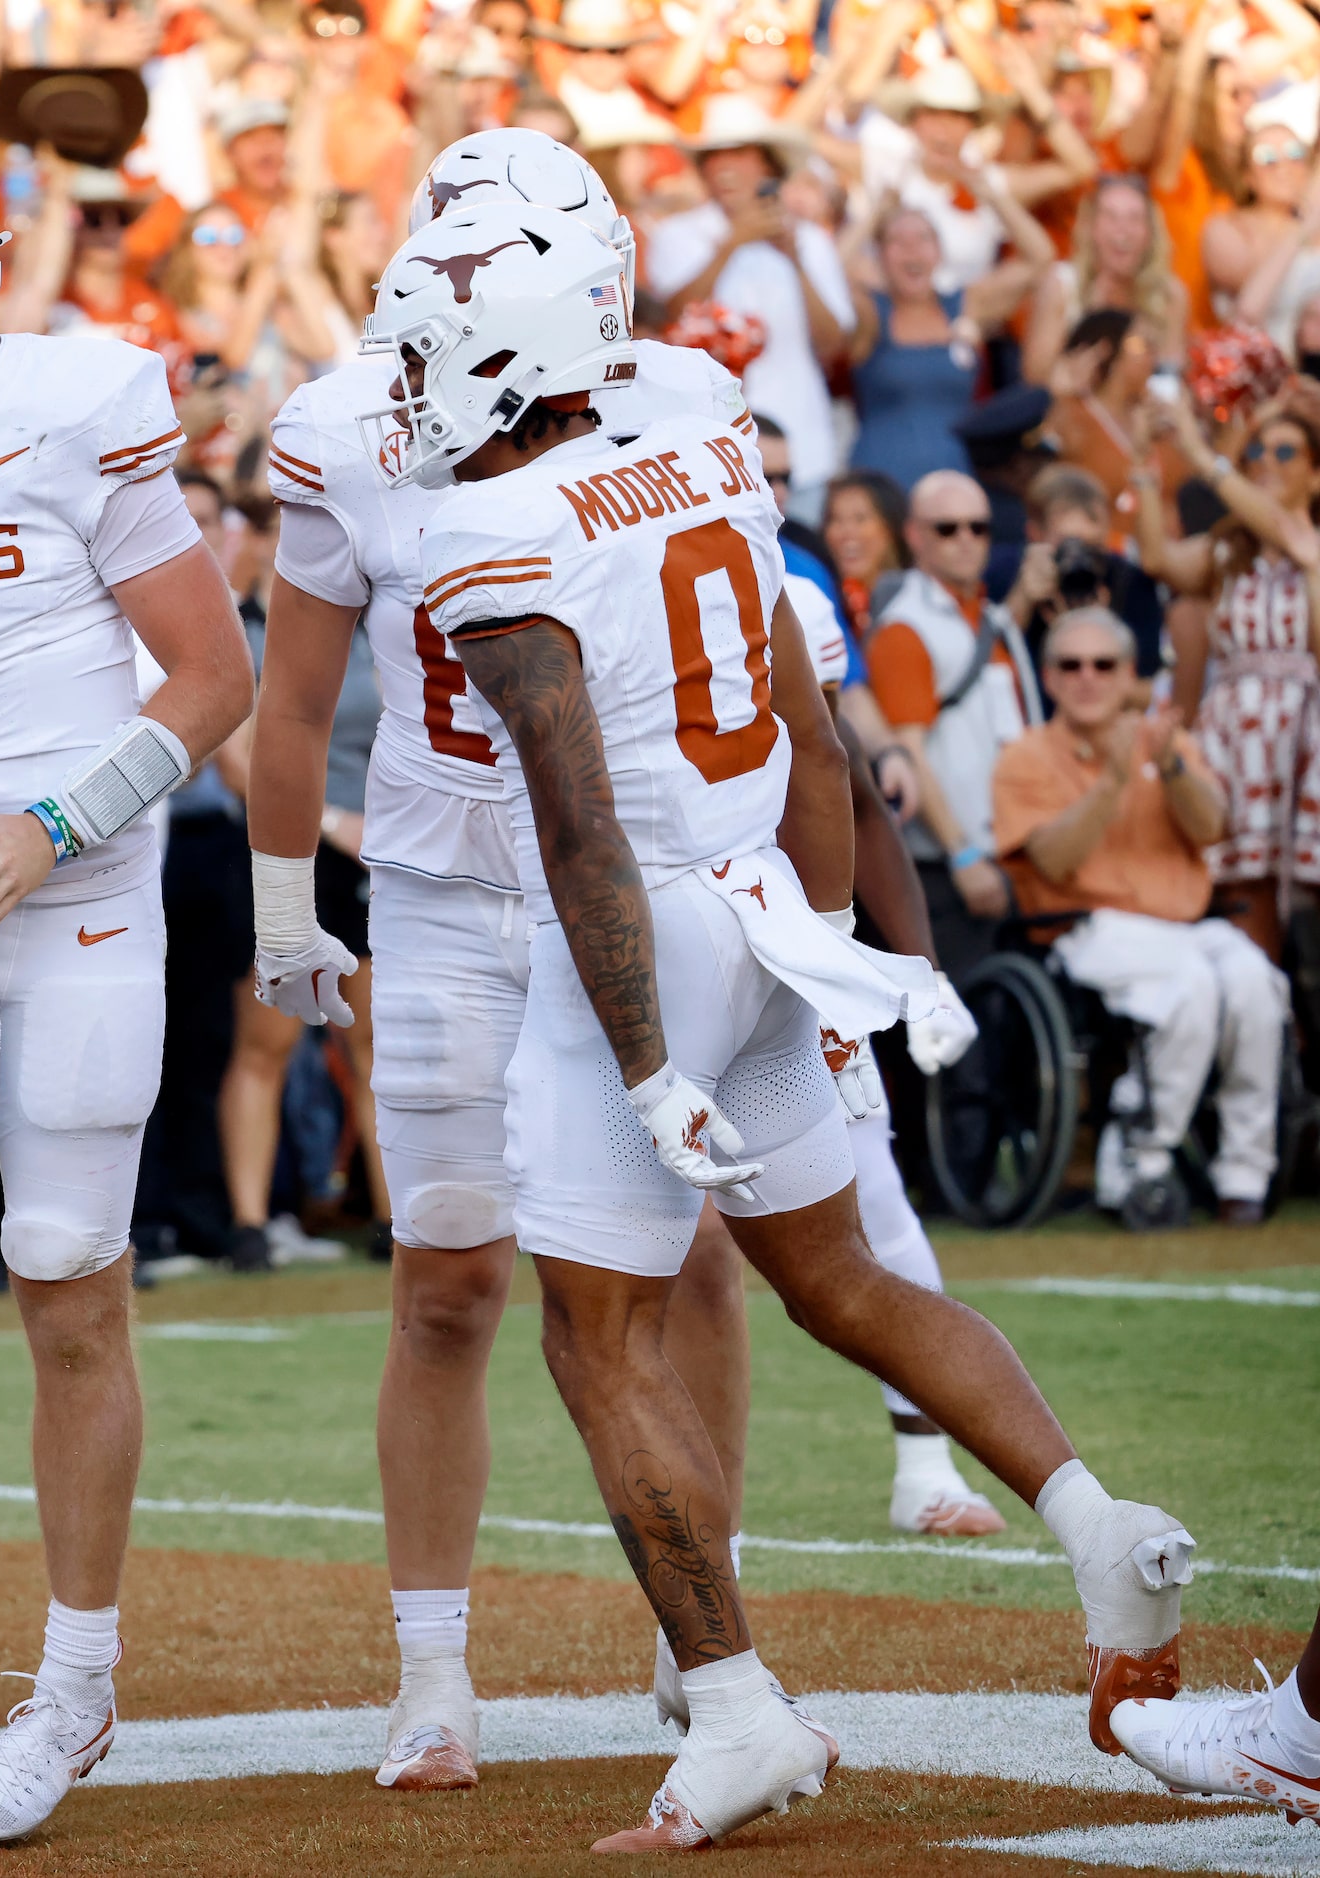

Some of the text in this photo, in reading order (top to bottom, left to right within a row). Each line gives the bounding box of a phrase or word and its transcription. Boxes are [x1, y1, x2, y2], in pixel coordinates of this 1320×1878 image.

[599, 313, 619, 341] SEC
[556, 450, 711, 542] MOORE
[659, 516, 780, 785] 0
